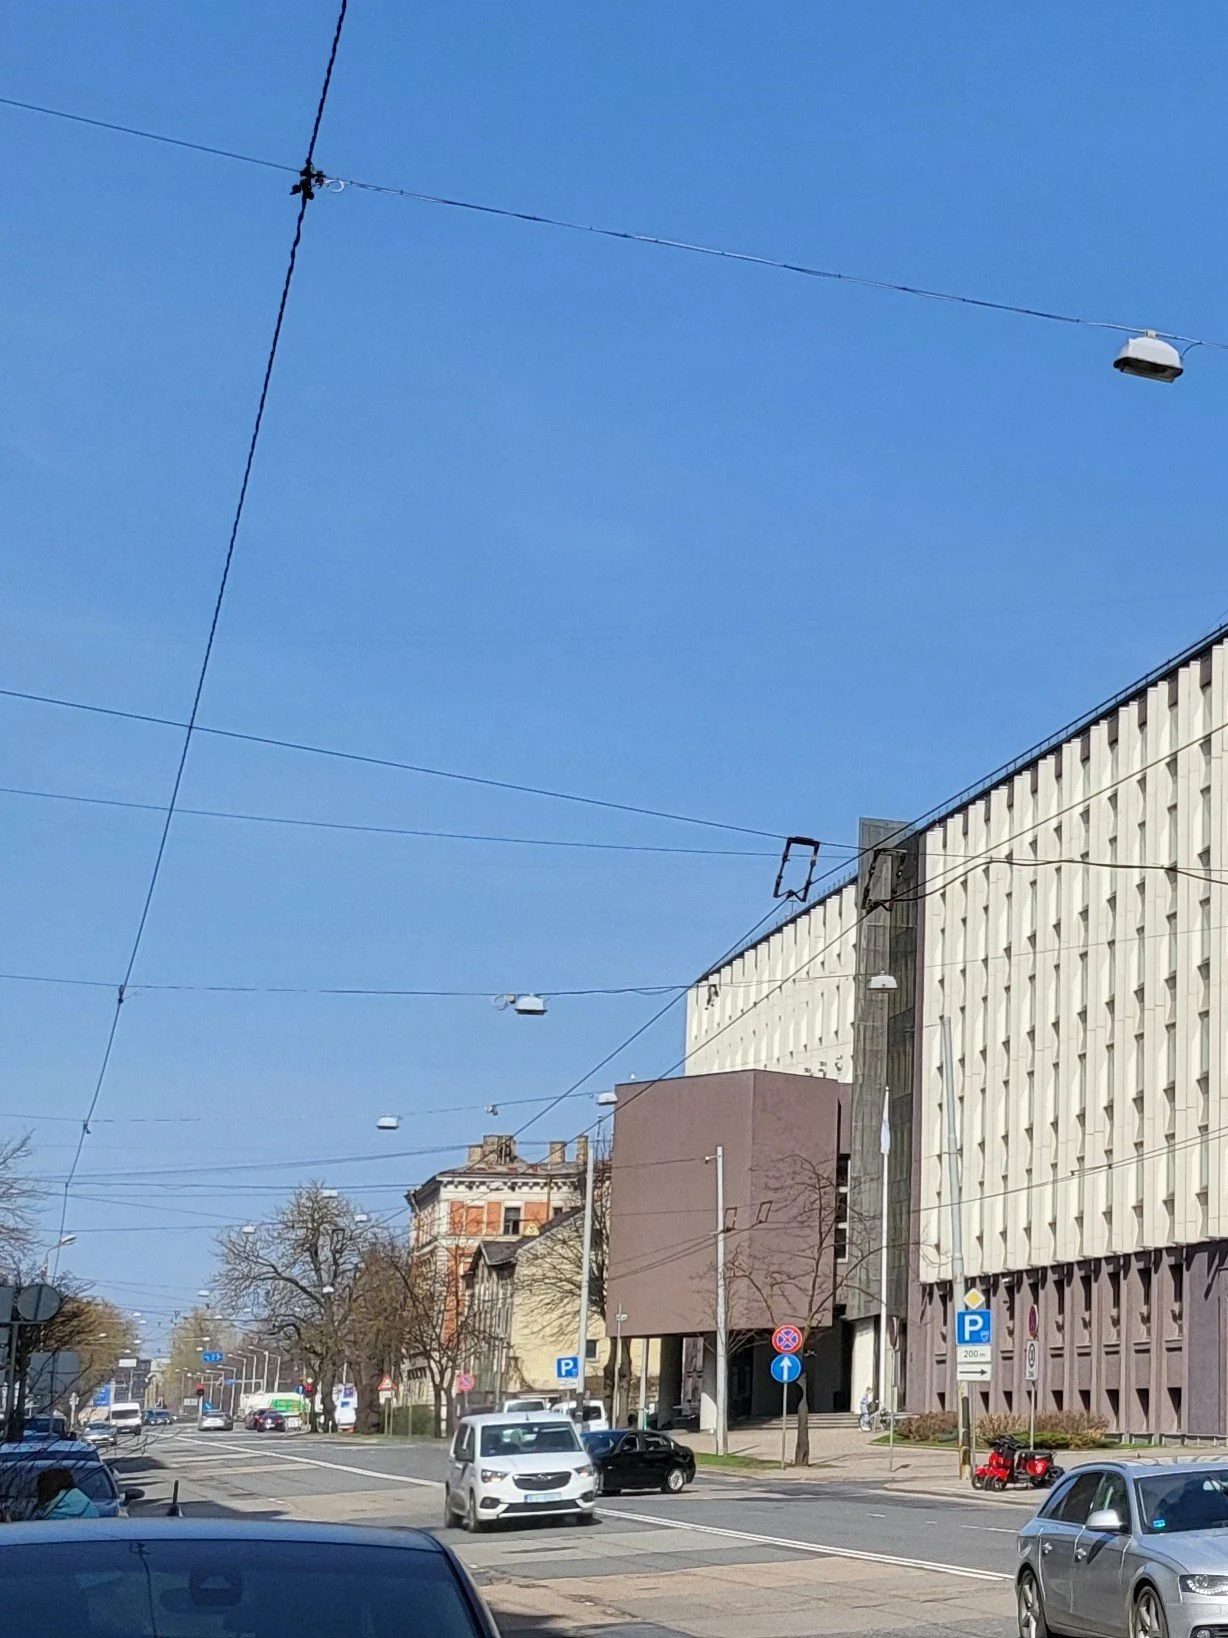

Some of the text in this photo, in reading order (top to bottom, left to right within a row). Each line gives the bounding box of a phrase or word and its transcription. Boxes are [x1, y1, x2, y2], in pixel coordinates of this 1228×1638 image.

[964, 1315, 983, 1340] P
[963, 1350, 979, 1358] 200
[561, 1360, 574, 1377] P
